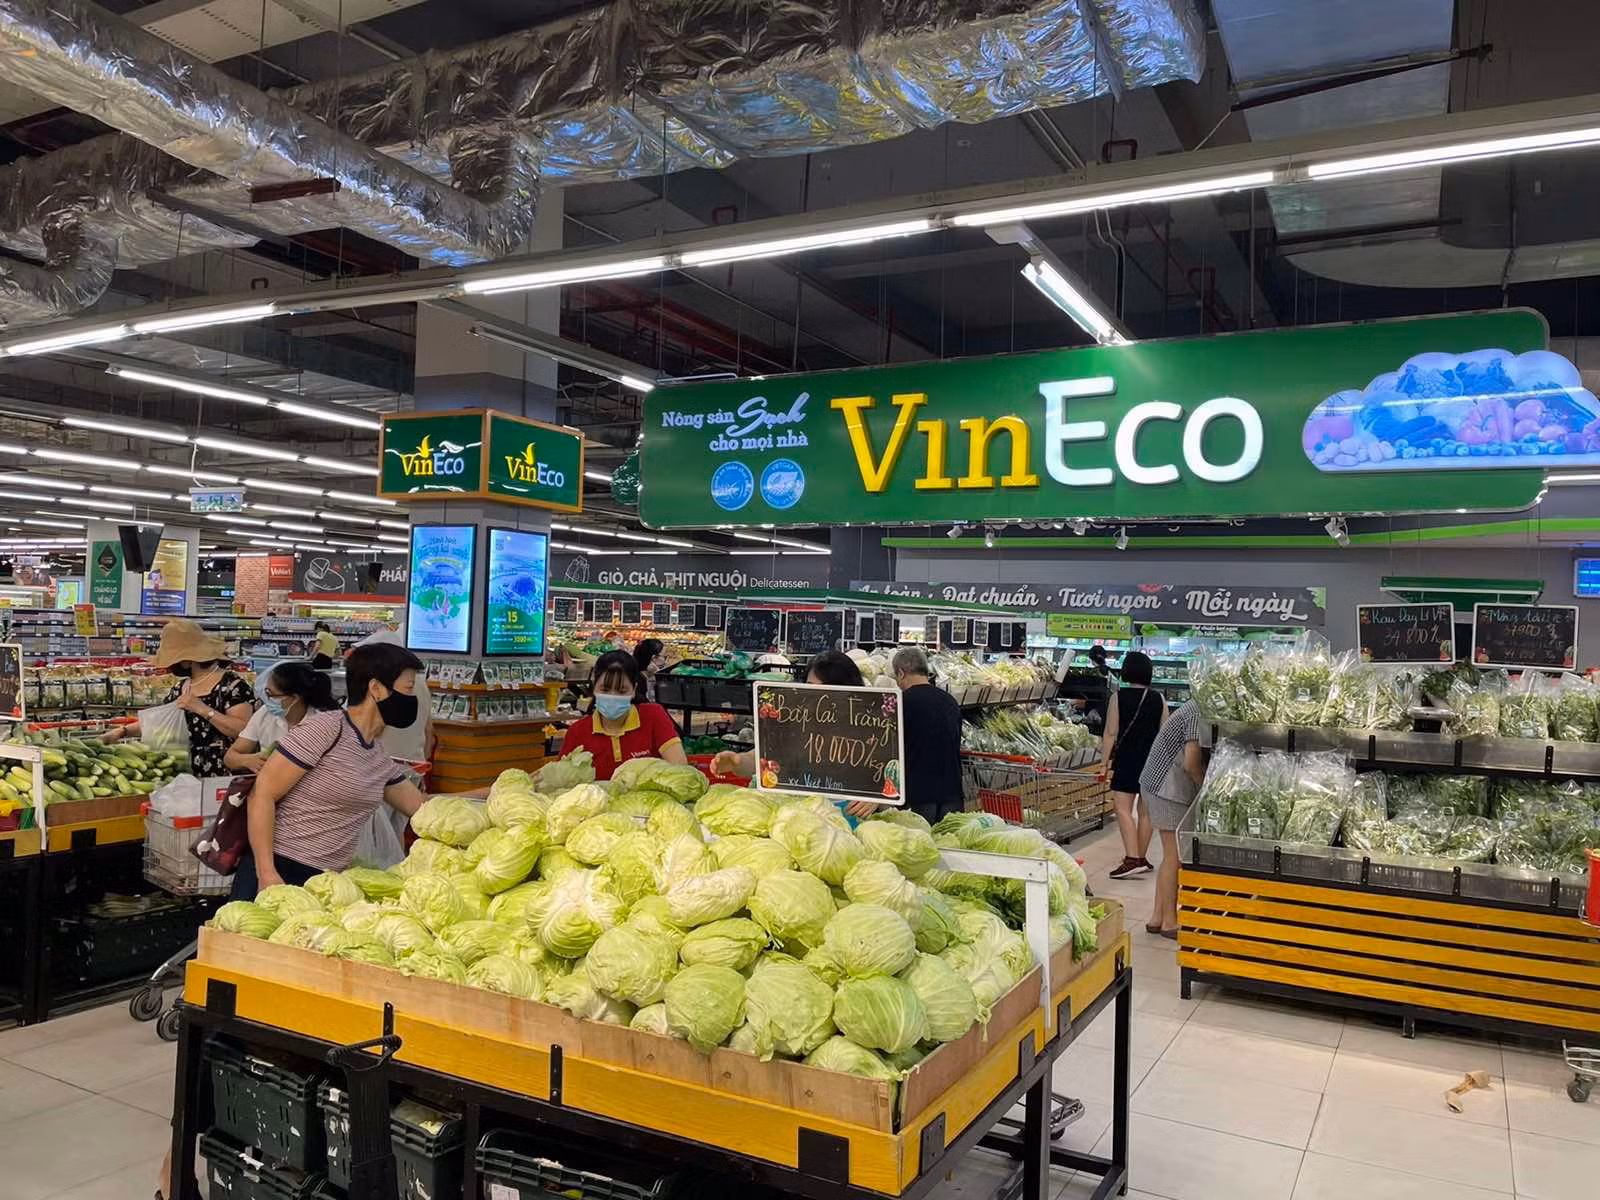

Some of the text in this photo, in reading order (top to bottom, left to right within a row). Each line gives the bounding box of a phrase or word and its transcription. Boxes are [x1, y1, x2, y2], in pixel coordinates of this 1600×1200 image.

[662, 392, 810, 437] Nông sản Sạch
[709, 430, 809, 451] cho mọi nhà
[830, 376, 1265, 493] VinEco
[400, 450, 465, 476] VinEco
[505, 453, 565, 488] VinEco
[698, 569, 747, 591] NGUỘI
[750, 576, 809, 589] Delicatessen
[979, 584, 1039, 607] chuẩn
[1058, 587, 1161, 614] Tươi ngon
[1185, 588, 1308, 621] Mỗi ngày
[777, 694, 812, 732] Bắp
[815, 694, 838, 723] Cải
